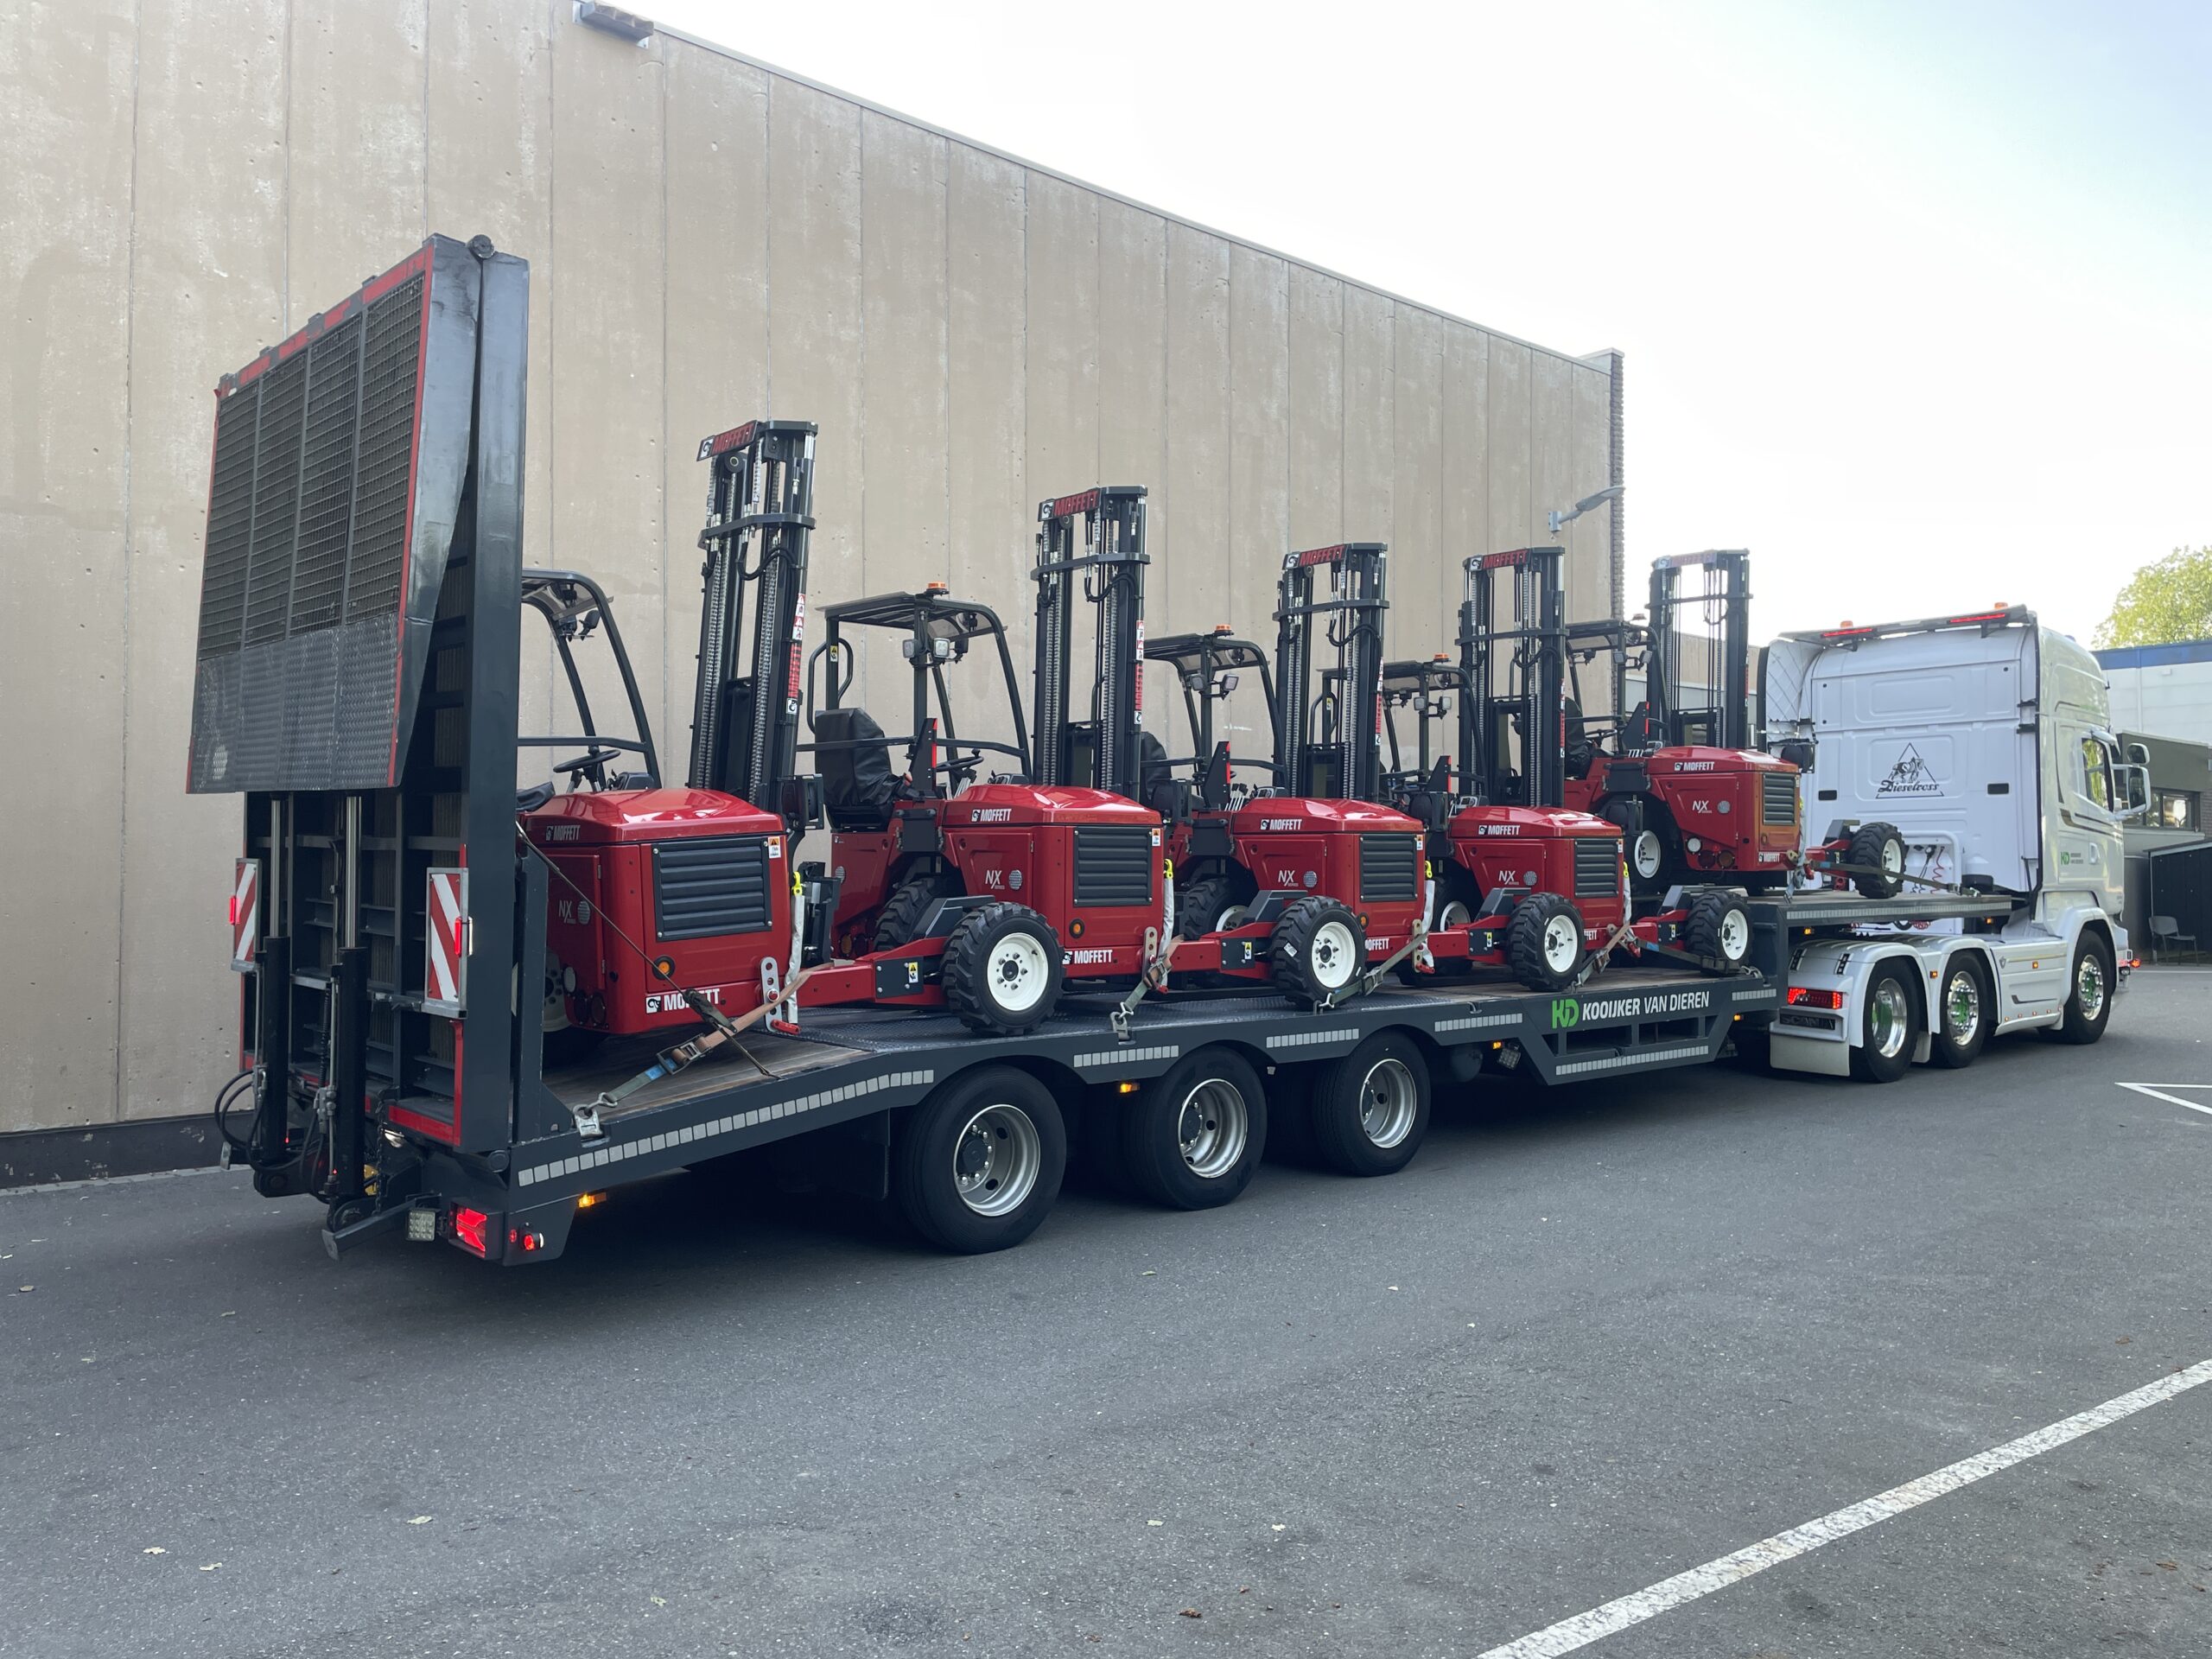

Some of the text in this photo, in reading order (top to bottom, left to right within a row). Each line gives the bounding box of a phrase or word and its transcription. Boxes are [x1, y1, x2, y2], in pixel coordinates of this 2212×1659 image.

[1055, 490, 1098, 516] MOFFETT
[1299, 545, 1344, 566] MOFFETT
[1482, 550, 1528, 569] MOFFETT
[1683, 761, 1715, 771] MOFFETT
[980, 808, 1012, 822] MOFFETT
[1692, 800, 1709, 813] NX
[553, 824, 581, 841] MOFFETT
[1269, 818, 1302, 830] MOFFETT
[1487, 824, 1521, 836] MOFFETT
[985, 869, 1002, 889] NX
[1278, 869, 1295, 887] NX
[1498, 870, 1516, 885] NX
[558, 899, 572, 923] NX
[1074, 950, 1113, 963] MOFFETT
[1582, 998, 1641, 1021] KOOIJKER
[1643, 995, 1668, 1014] VAN
[1669, 991, 1709, 1011] DIEREN
